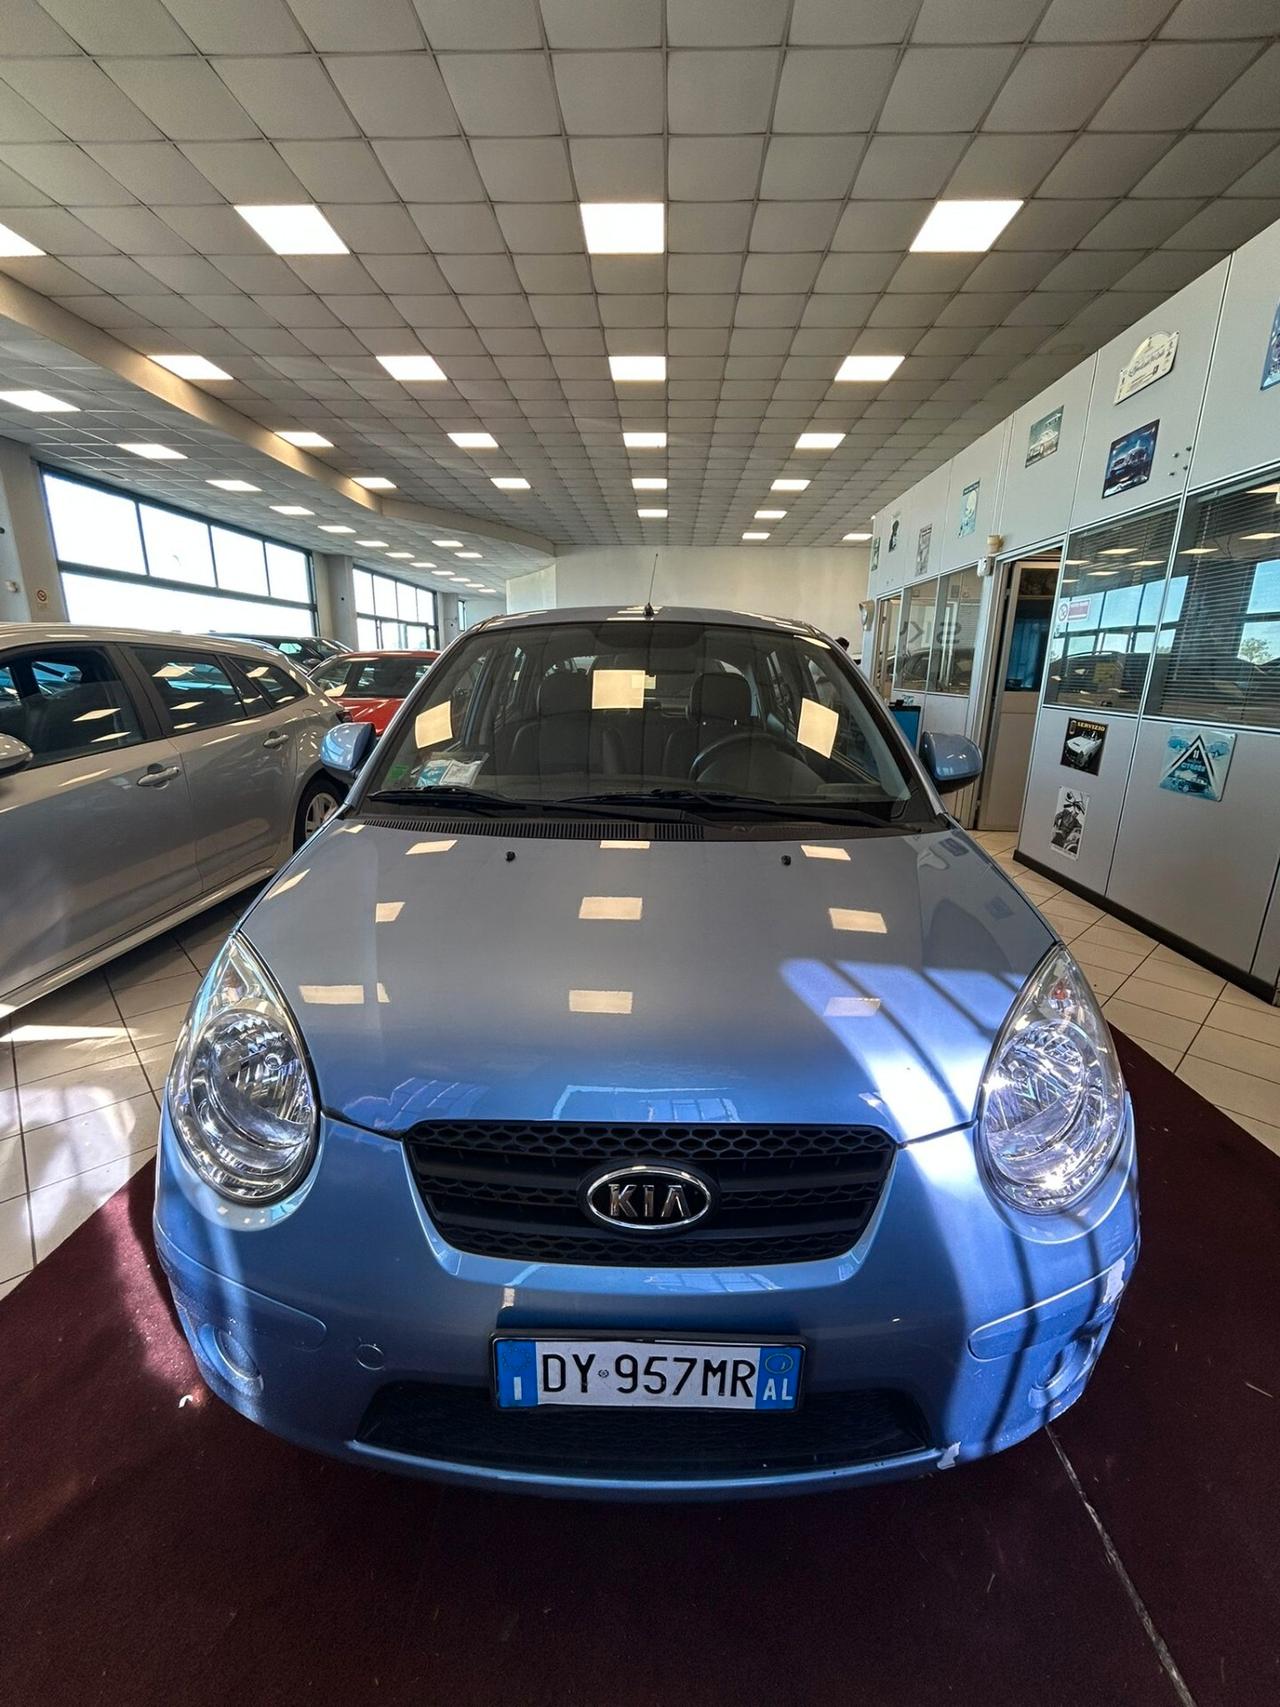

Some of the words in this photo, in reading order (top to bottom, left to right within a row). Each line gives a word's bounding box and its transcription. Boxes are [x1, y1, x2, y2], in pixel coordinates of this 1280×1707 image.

[608, 1183, 692, 1218] KIA
[513, 1376, 522, 1400] I
[542, 1353, 596, 1394] DY
[614, 1353, 756, 1398] 957MR
[763, 1378, 793, 1401] AL
